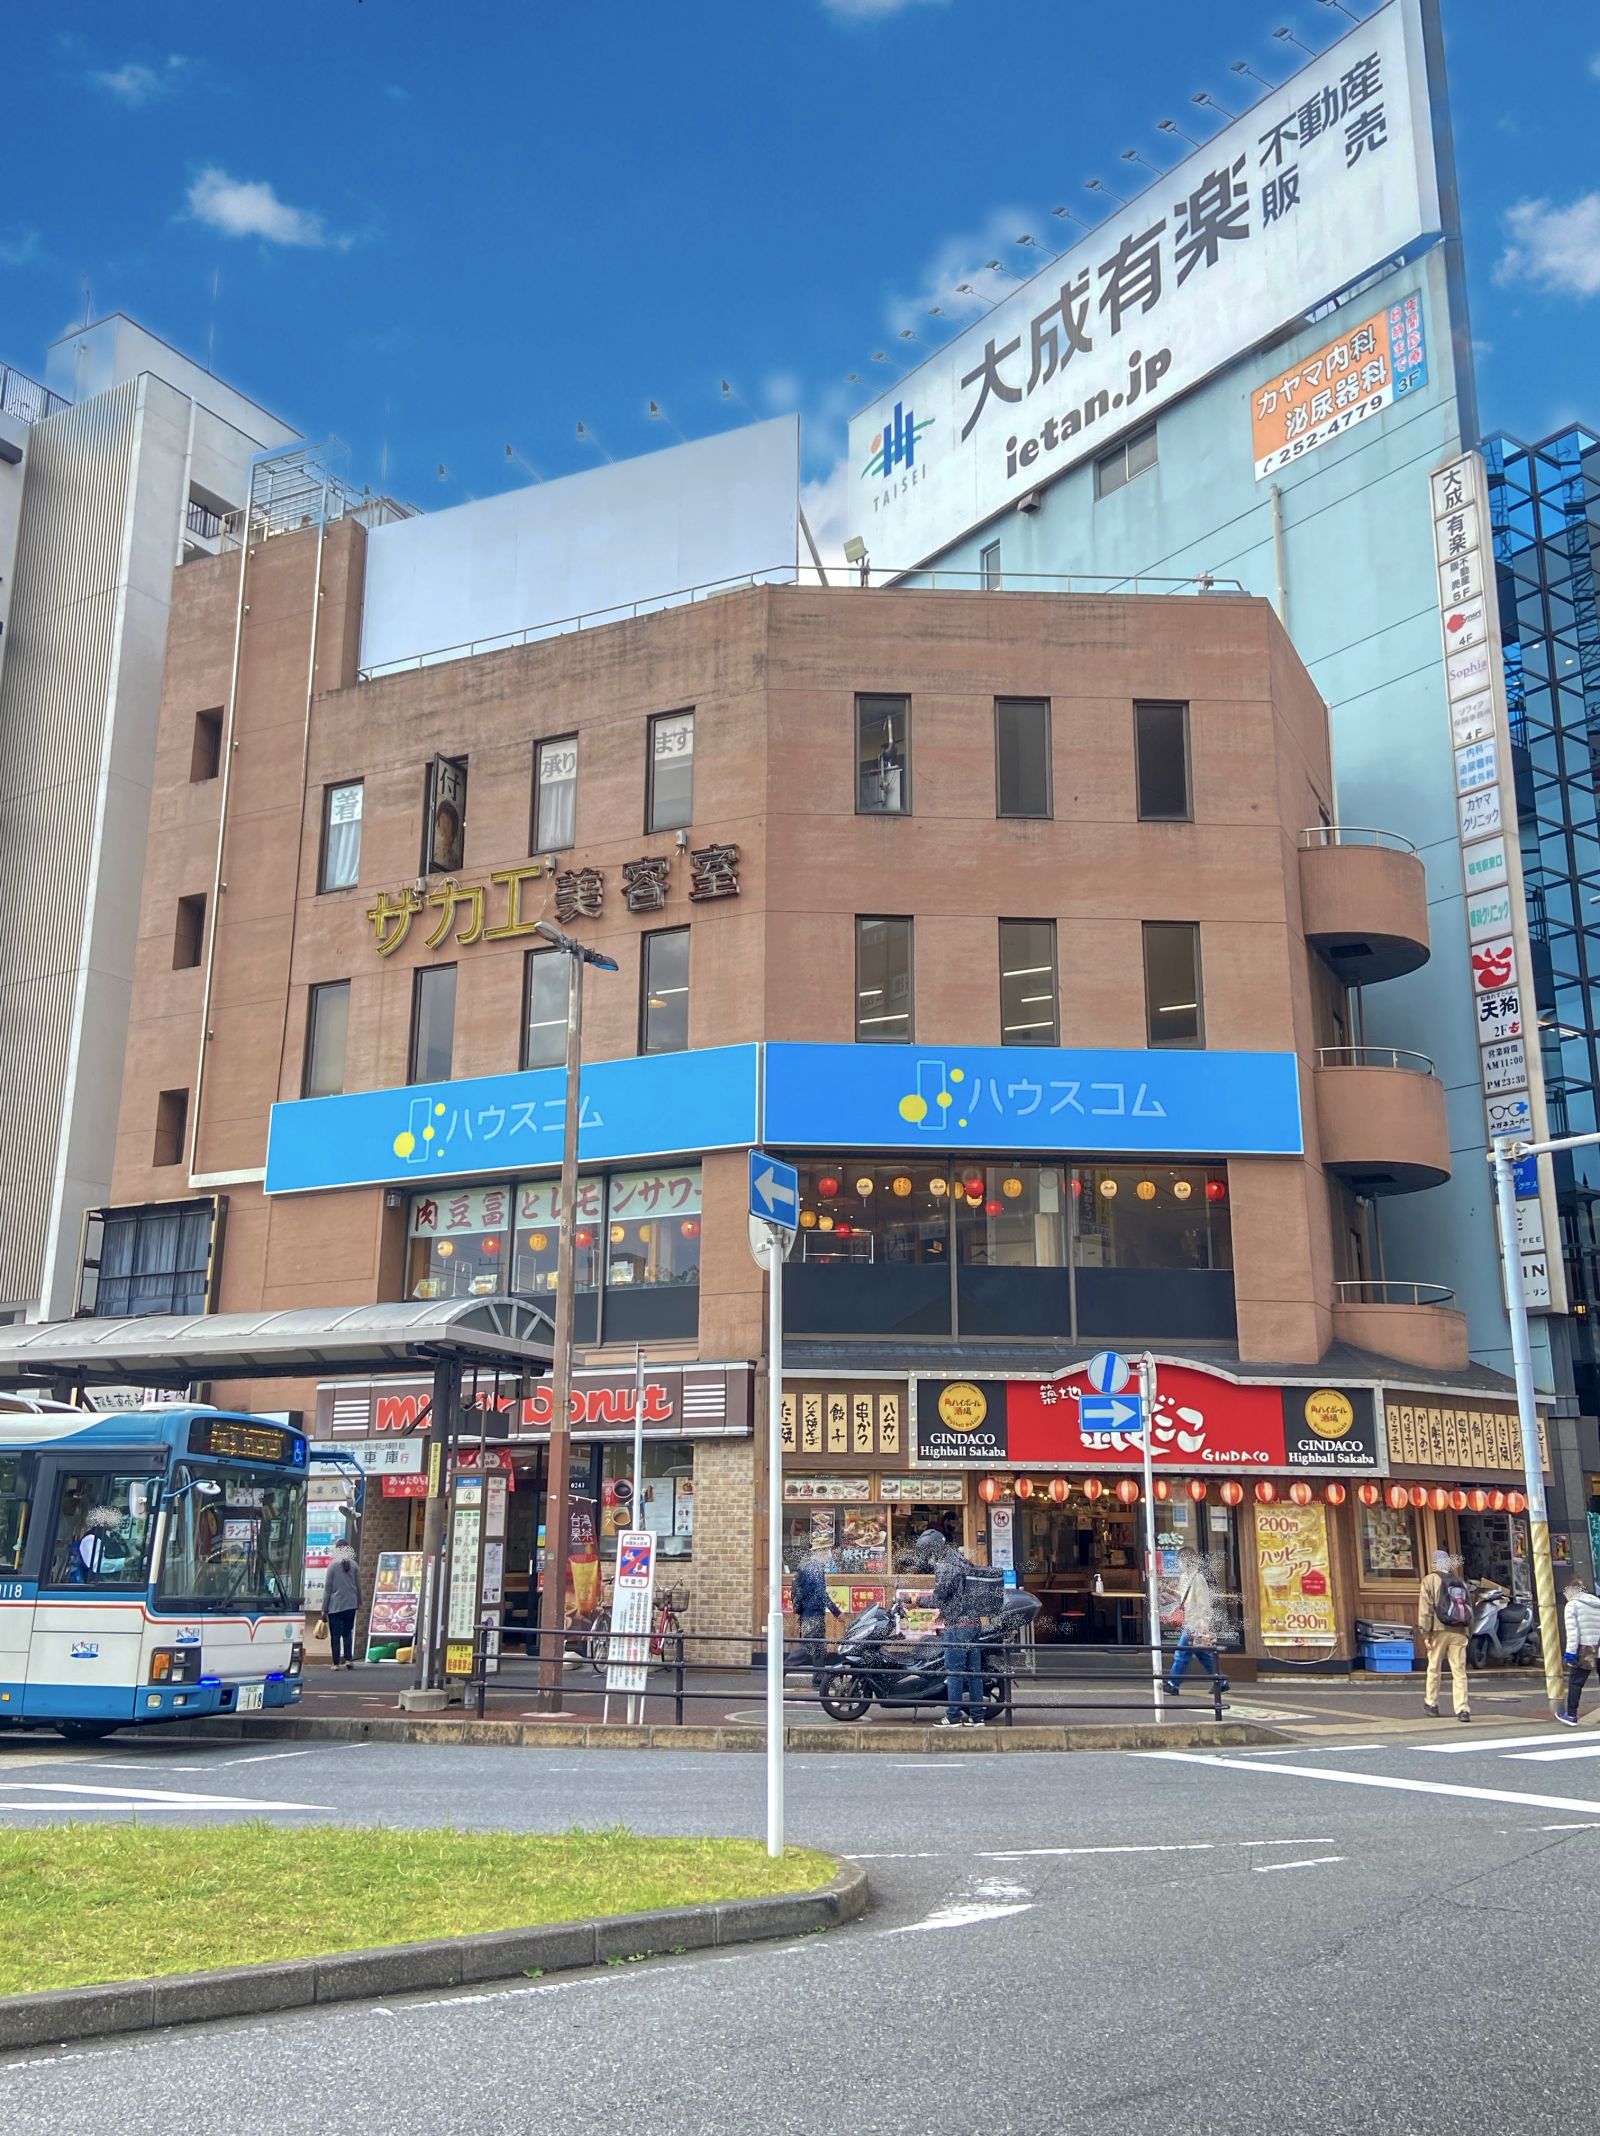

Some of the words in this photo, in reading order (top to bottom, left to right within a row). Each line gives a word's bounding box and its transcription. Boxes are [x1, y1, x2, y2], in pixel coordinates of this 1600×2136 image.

[1258, 51, 1384, 168] 不動産
[961, 152, 1250, 443] 大成有楽
[1257, 323, 1377, 421] カヤマ内科
[1398, 370, 1421, 393] 3F
[1285, 354, 1388, 441] 泌尿器科
[1006, 348, 1172, 479] ietan.jp
[1279, 394, 1383, 464] 252-4779
[873, 463, 926, 513] TAISEI
[1453, 587, 1470, 601] 5F
[1459, 633, 1473, 646] 4F
[1449, 659, 1488, 681] Sophia
[1465, 727, 1483, 741] 4F
[333, 789, 360, 822] 着
[439, 767, 461, 801] 付
[541, 751, 577, 778] 承り
[654, 728, 693, 754] ます
[1466, 793, 1492, 812] カヤマ
[1463, 808, 1499, 833] クリニック
[1480, 996, 1519, 1022] 天狗
[1494, 1024, 1508, 1038] 2F
[1488, 1044, 1518, 1059] 営業時間
[968, 1078, 1168, 1117] ハウスコム
[1490, 1117, 1530, 1131] メガネスーパー
[1040, 1384, 1082, 1405] 築地
[830, 1403, 846, 1442] 餃子
[856, 1402, 871, 1445] 串かつ
[883, 1402, 896, 1445] ハムカツ
[930, 1433, 996, 1445] GINDACO
[1298, 1440, 1363, 1452] GINDACO
[1418, 1413, 1428, 1457] からあげ
[1445, 1417, 1455, 1458] ハムカツ
[1458, 1417, 1469, 1459] 串かつ
[920, 1446, 966, 1459] Highball
[969, 1446, 1006, 1457] Sakaba
[1201, 1448, 1269, 1462] GINDACO
[1288, 1452, 1335, 1465] Highball
[1337, 1453, 1374, 1463] Sakaba
[1259, 1516, 1299, 1532] 200円
[1259, 1544, 1312, 1566] ハッピー
[1285, 1560, 1326, 1579] アワー
[1286, 1613, 1328, 1630] 290円
